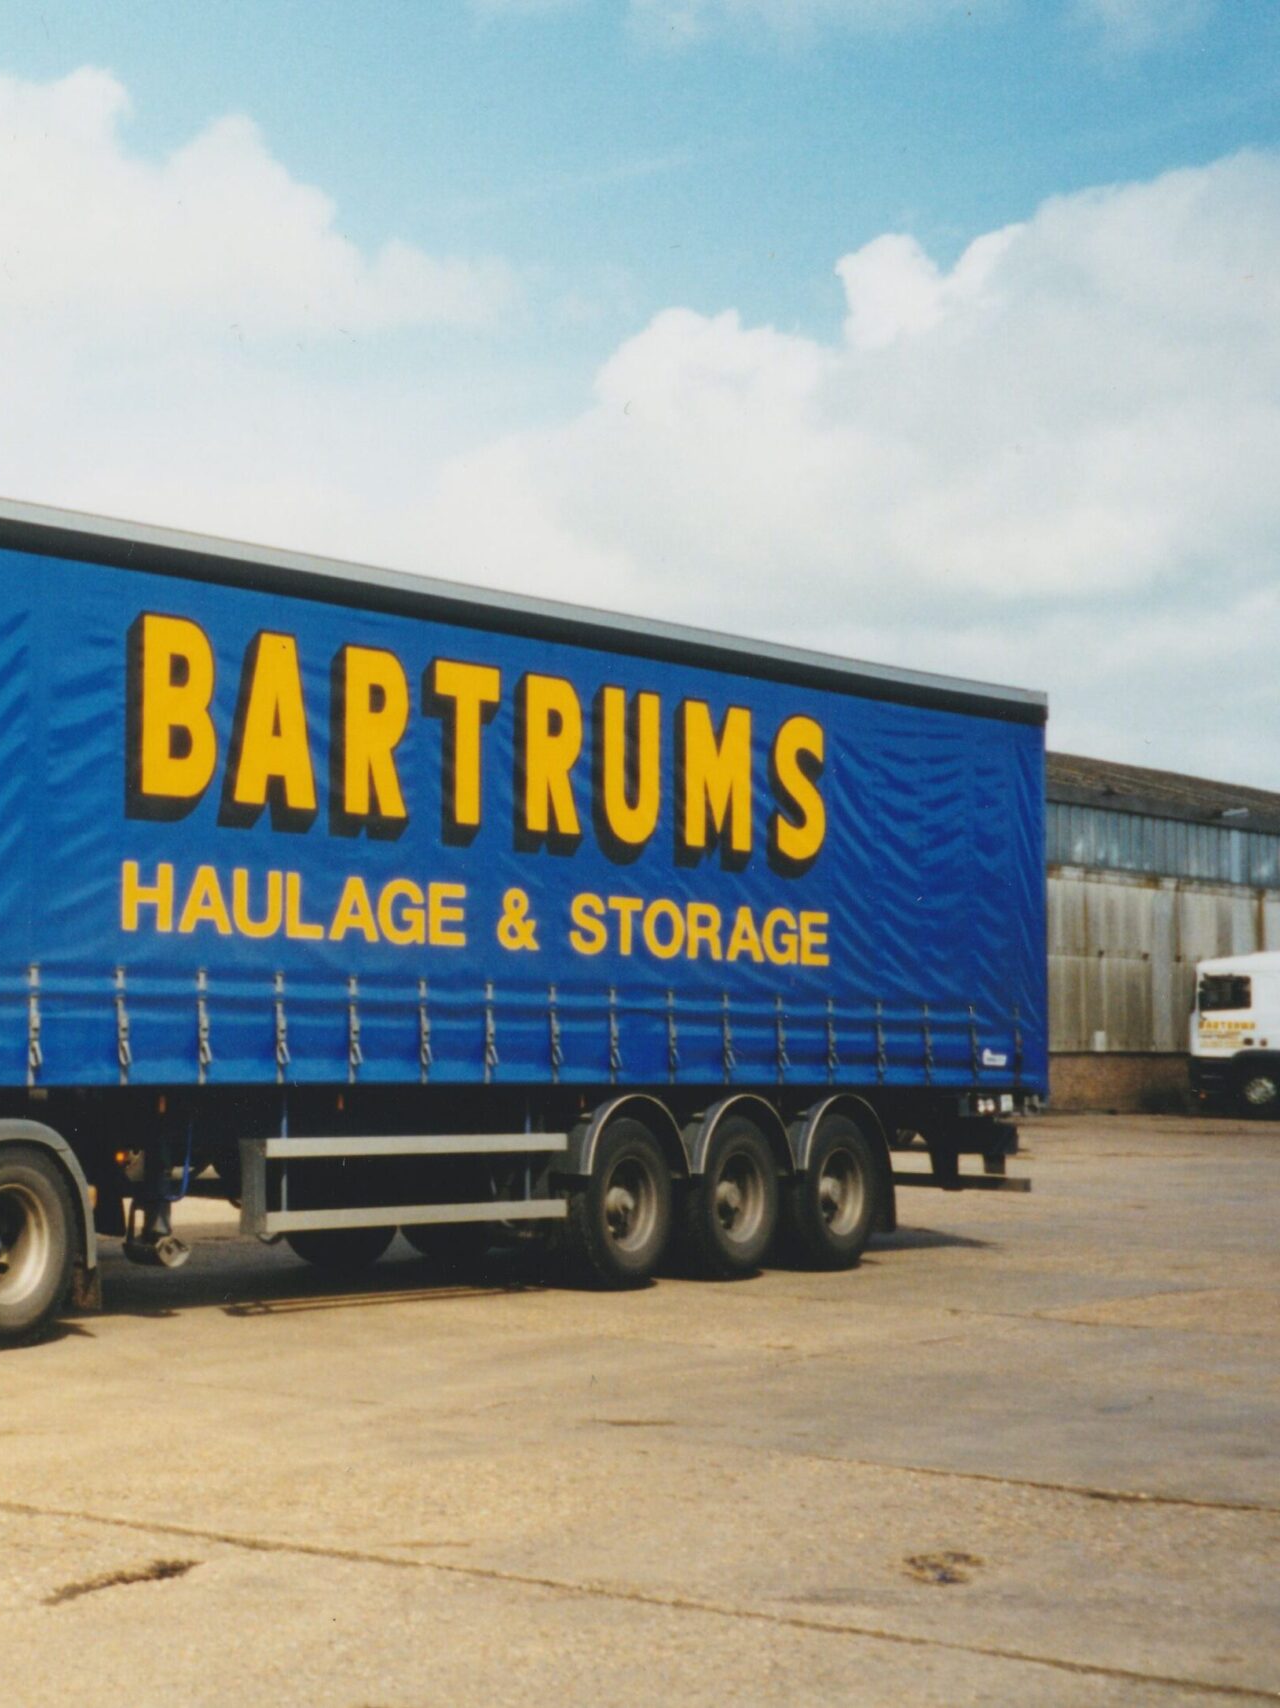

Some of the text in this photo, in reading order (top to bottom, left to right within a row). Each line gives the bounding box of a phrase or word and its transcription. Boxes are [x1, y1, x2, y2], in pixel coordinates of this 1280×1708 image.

[125, 611, 826, 879] BARTRUMS
[121, 860, 830, 966] HAULAGE & STORAGE
